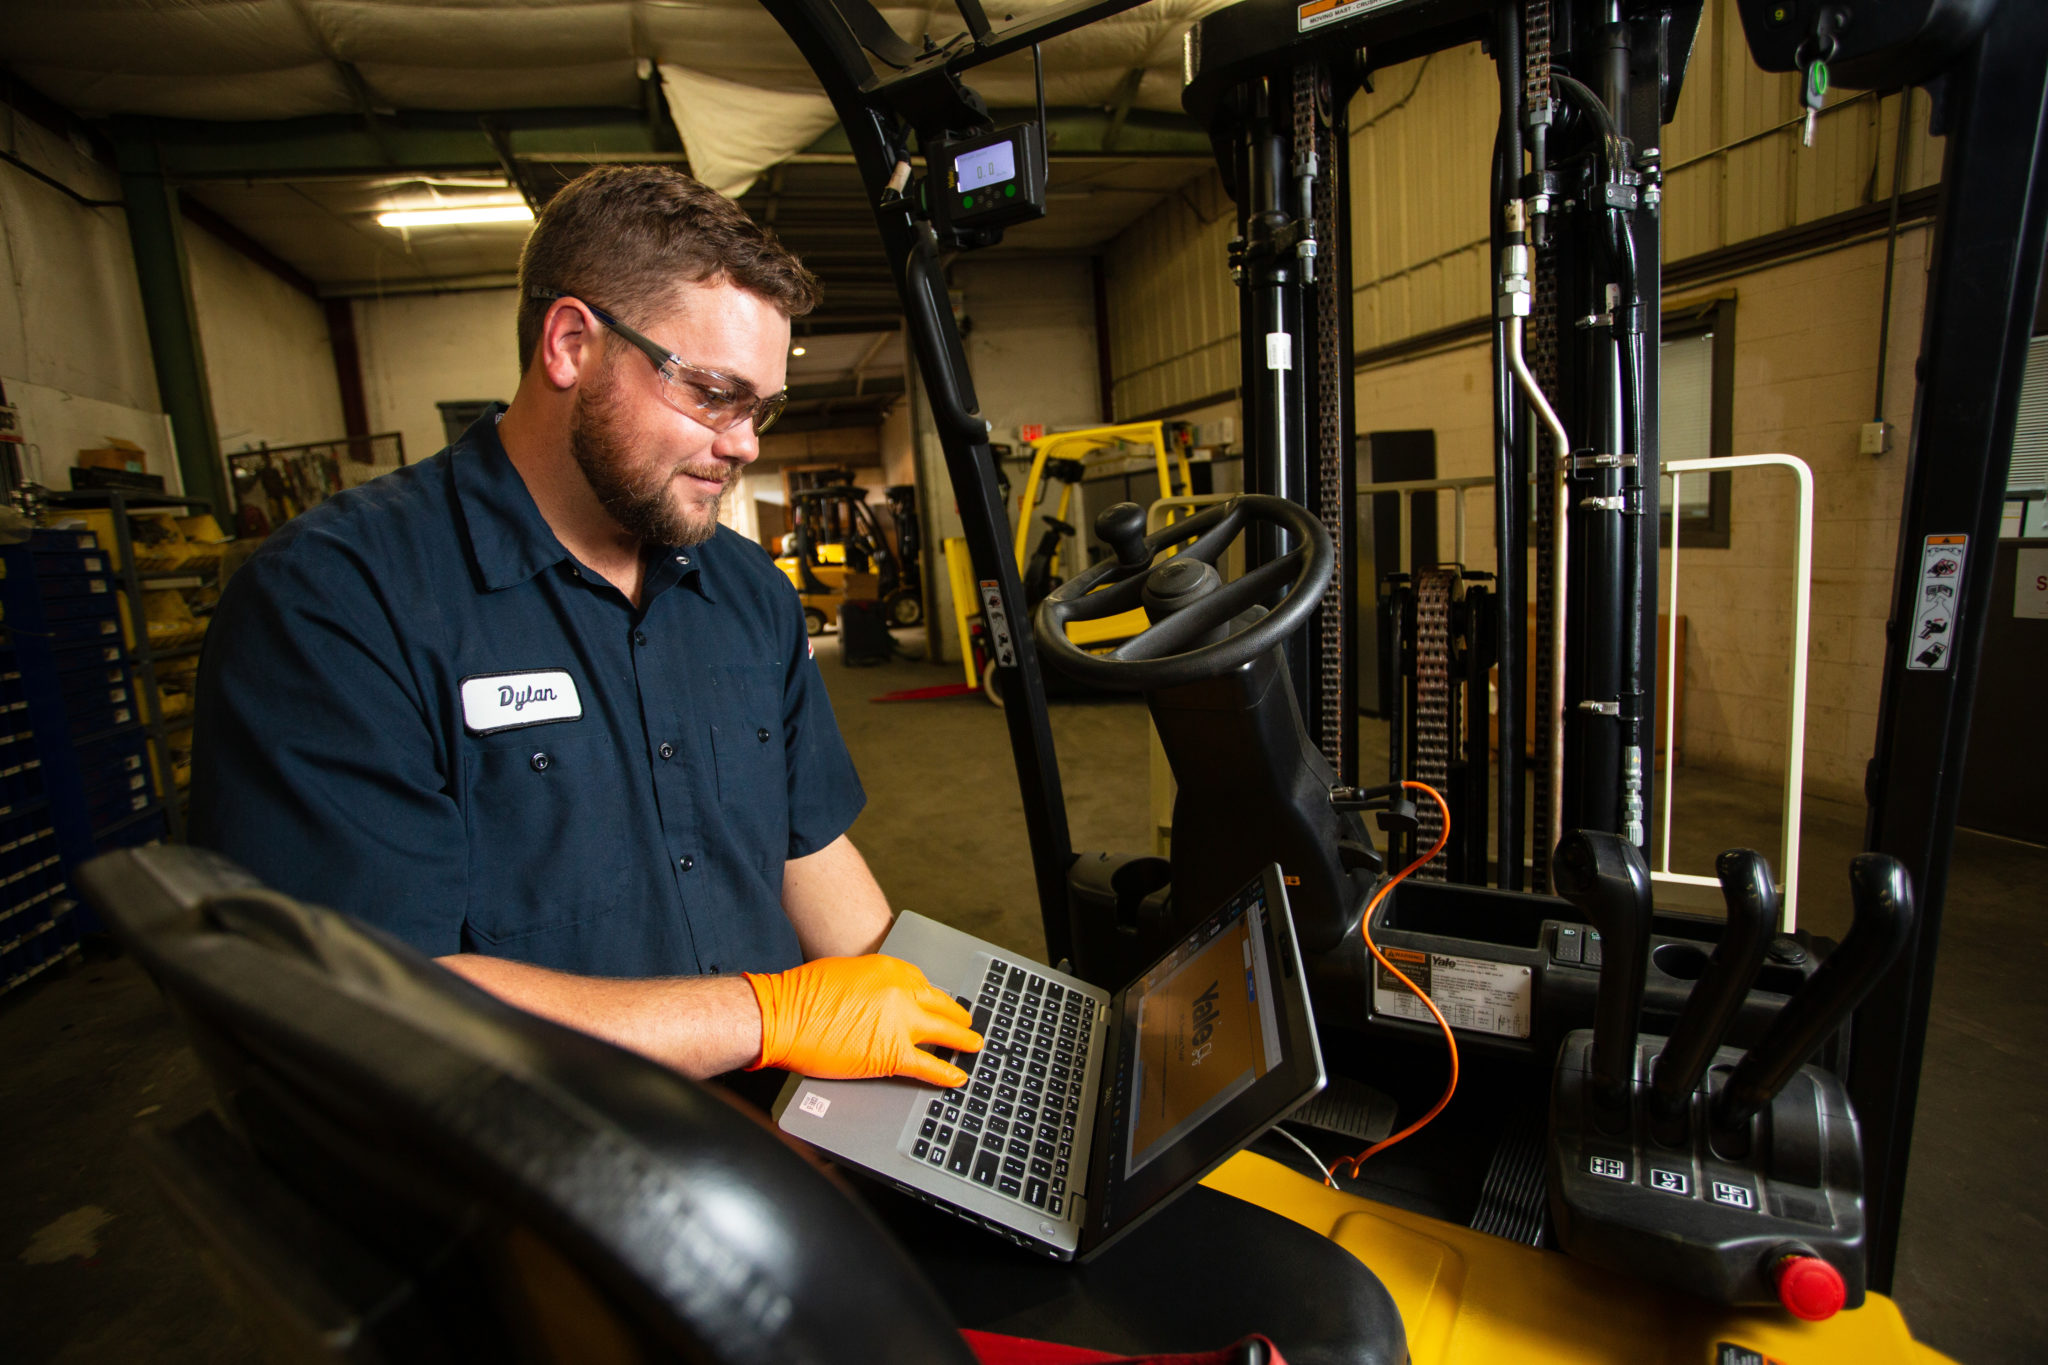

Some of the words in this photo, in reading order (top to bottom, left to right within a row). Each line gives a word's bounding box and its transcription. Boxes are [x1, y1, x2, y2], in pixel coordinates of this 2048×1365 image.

[1309, 12, 1333, 23] MOVING
[1334, 6, 1351, 15] MAST
[977, 162, 994, 179] 0.0
[498, 685, 557, 711] Dylan
[1433, 956, 1456, 967] Yale
[1192, 980, 1219, 1047] Yale
